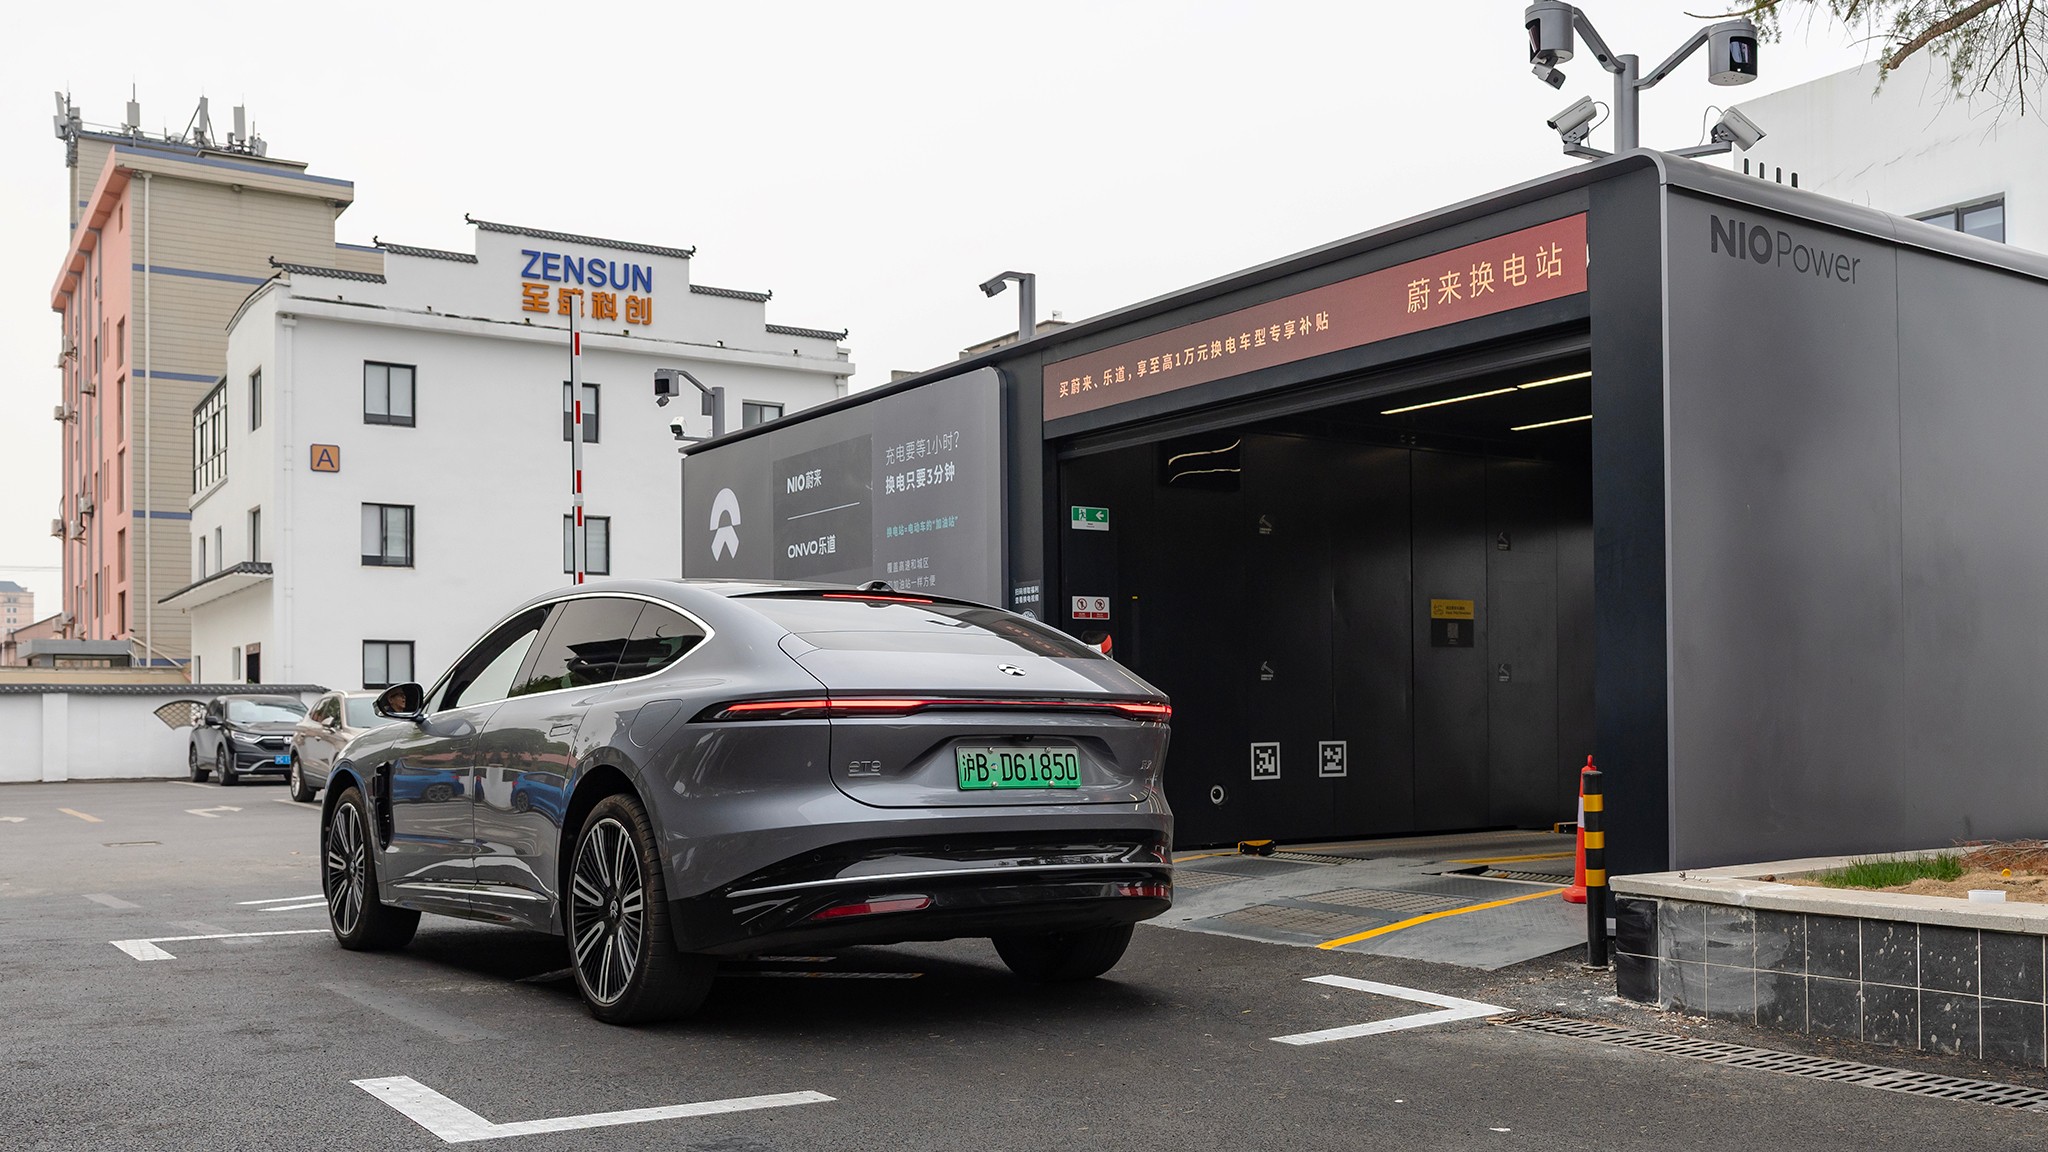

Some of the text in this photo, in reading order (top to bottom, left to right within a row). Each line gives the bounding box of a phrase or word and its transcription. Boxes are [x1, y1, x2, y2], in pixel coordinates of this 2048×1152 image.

[521, 249, 653, 293] ZENSUN
[1407, 241, 1563, 314] 蔚来换电站
[522, 282, 652, 325] 至盛科创
[316, 448, 335, 468] A
[885, 461, 955, 495] 换电只要3分钟
